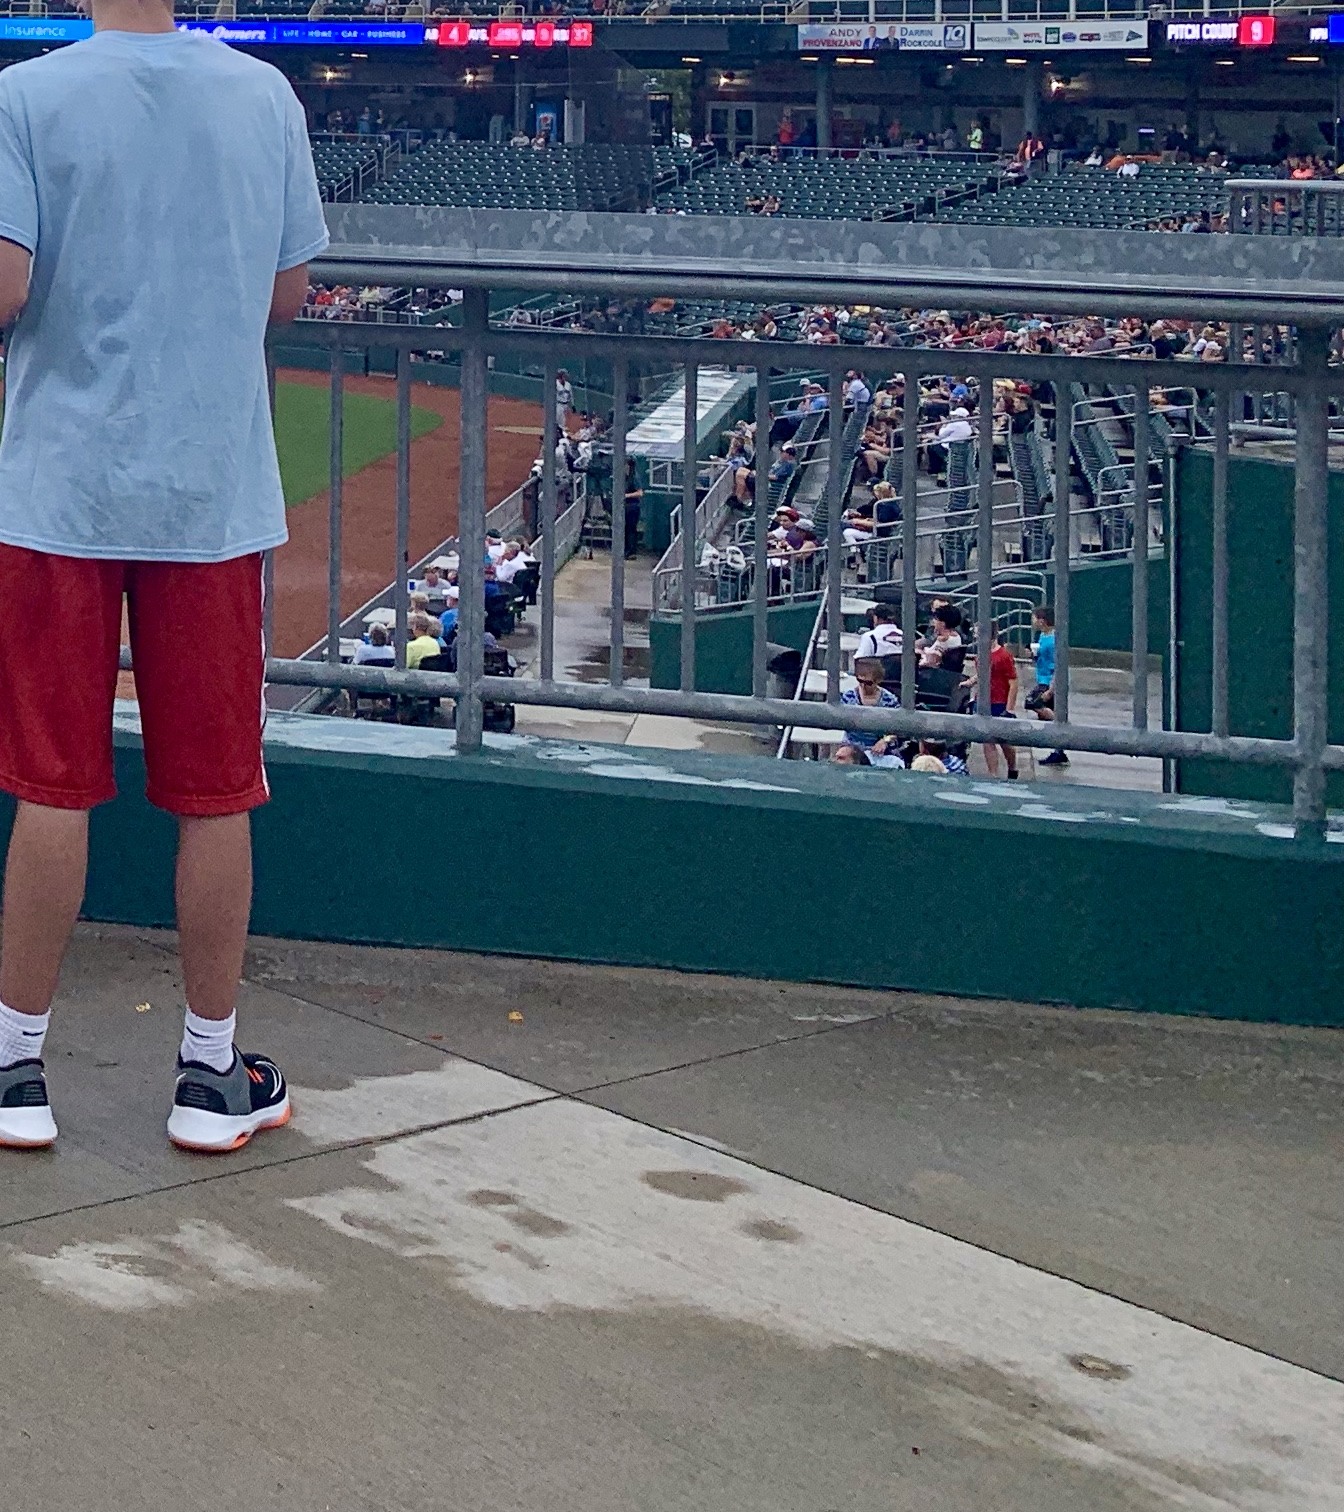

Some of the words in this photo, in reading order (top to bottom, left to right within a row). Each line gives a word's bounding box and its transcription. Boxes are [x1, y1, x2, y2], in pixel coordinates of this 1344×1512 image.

[5, 23, 66, 37] Insurance
[829, 28, 862, 37] ANDY
[1167, 24, 1200, 40] PITCH
[1202, 23, 1239, 39] COUNT
